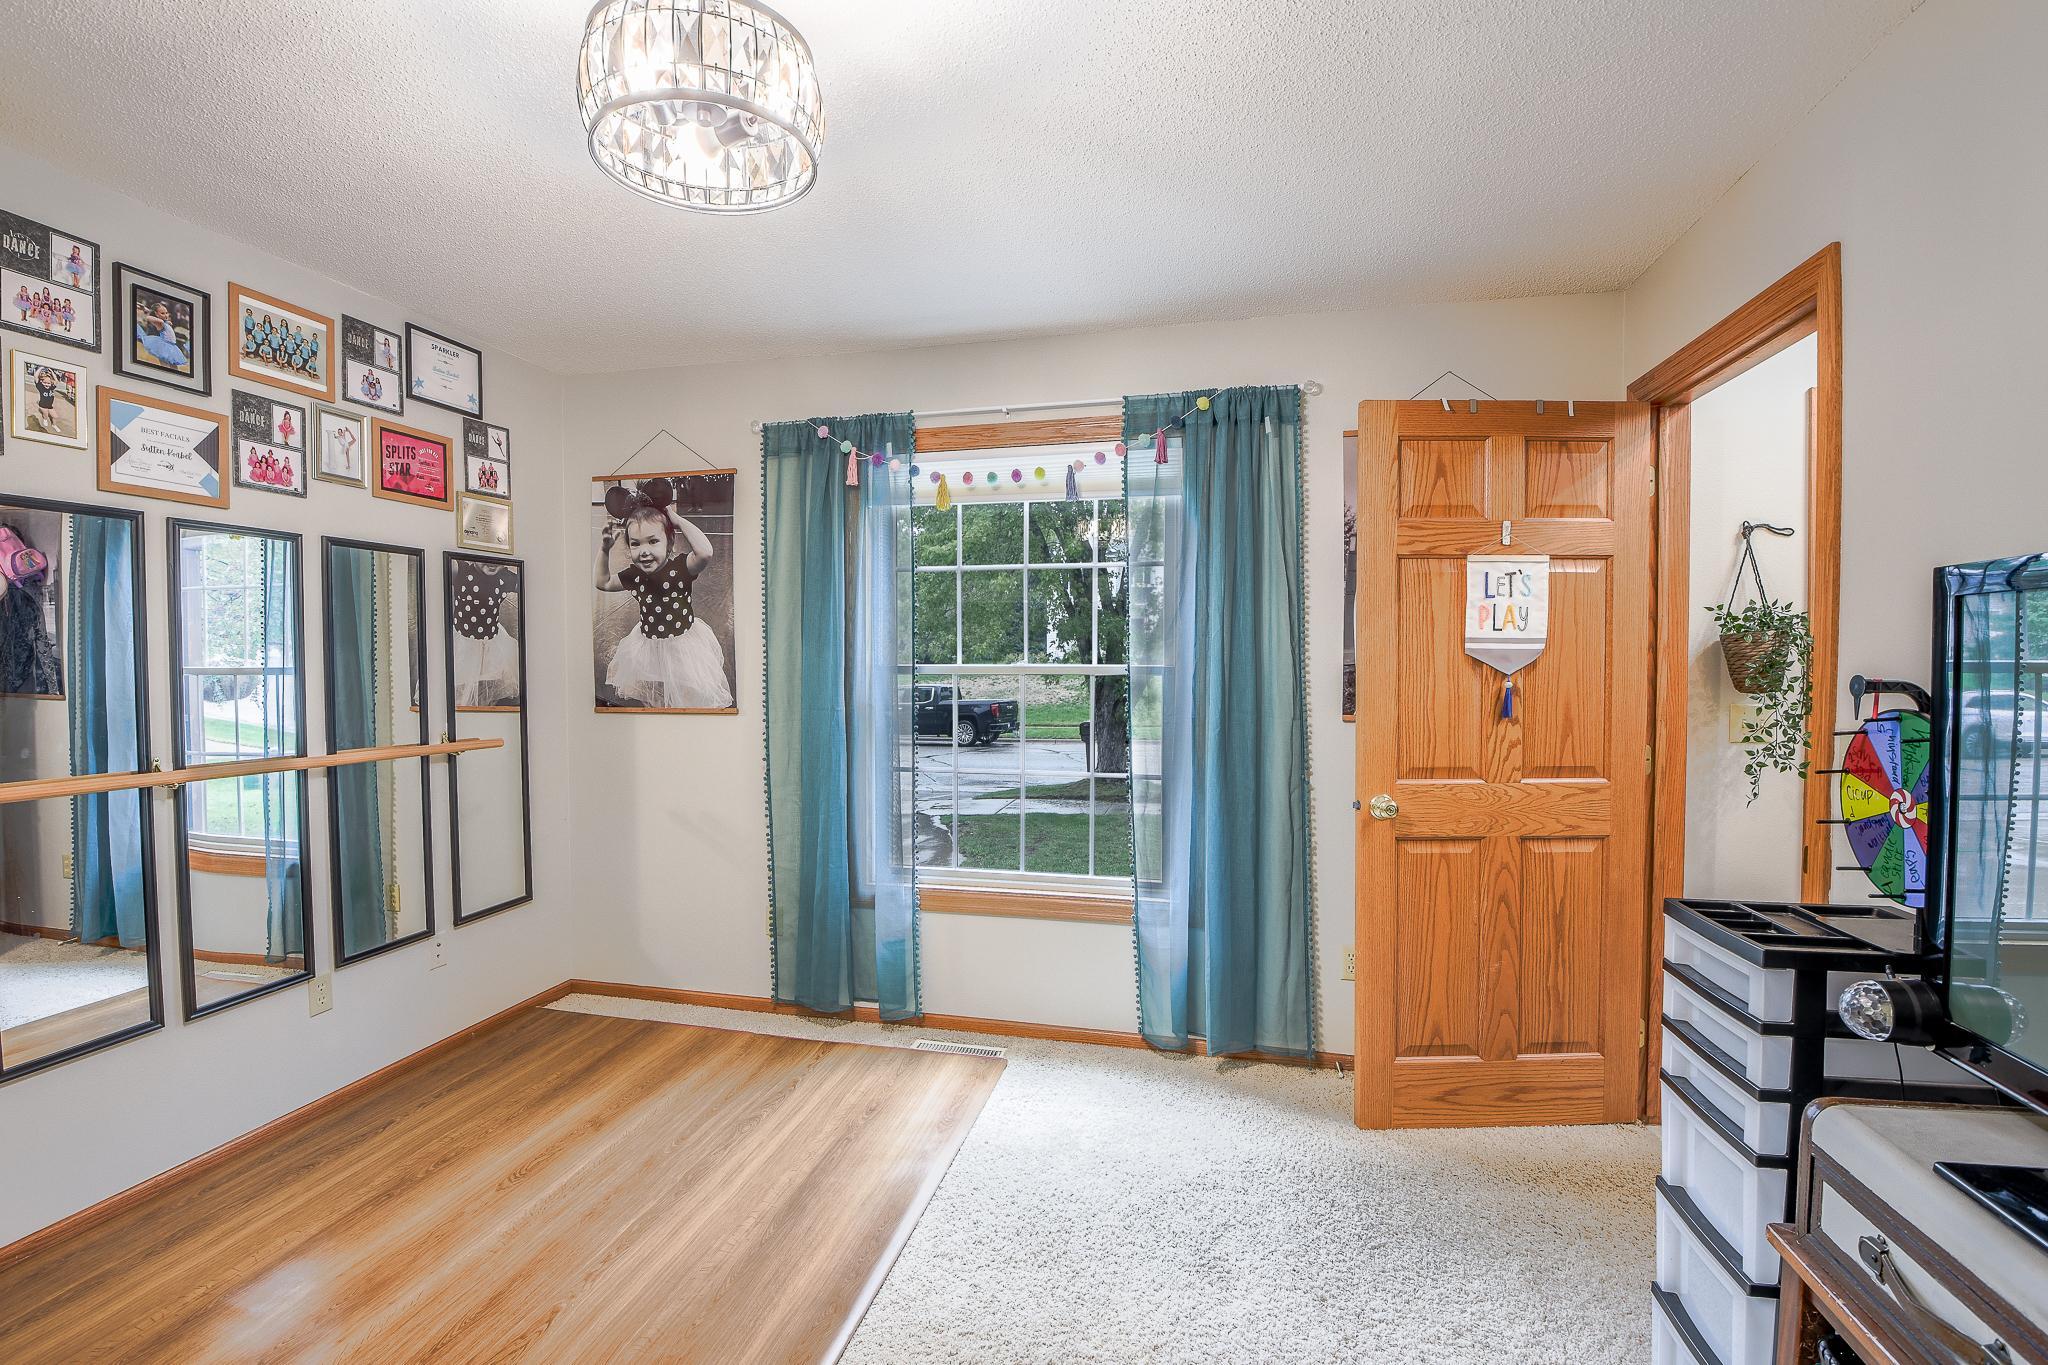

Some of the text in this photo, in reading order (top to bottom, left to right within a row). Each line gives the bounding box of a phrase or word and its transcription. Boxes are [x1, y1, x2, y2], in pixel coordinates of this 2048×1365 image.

[3, 234, 40, 259] DANCE
[431, 343, 460, 359] SPARKLER
[240, 410, 265, 428] DANCE
[140, 426, 190, 442] BEST FACIALS
[385, 445, 417, 460] SPLITS
[389, 462, 411, 476] STAR
[1484, 569, 1532, 599] LET'S
[1478, 603, 1529, 632] PLAY
